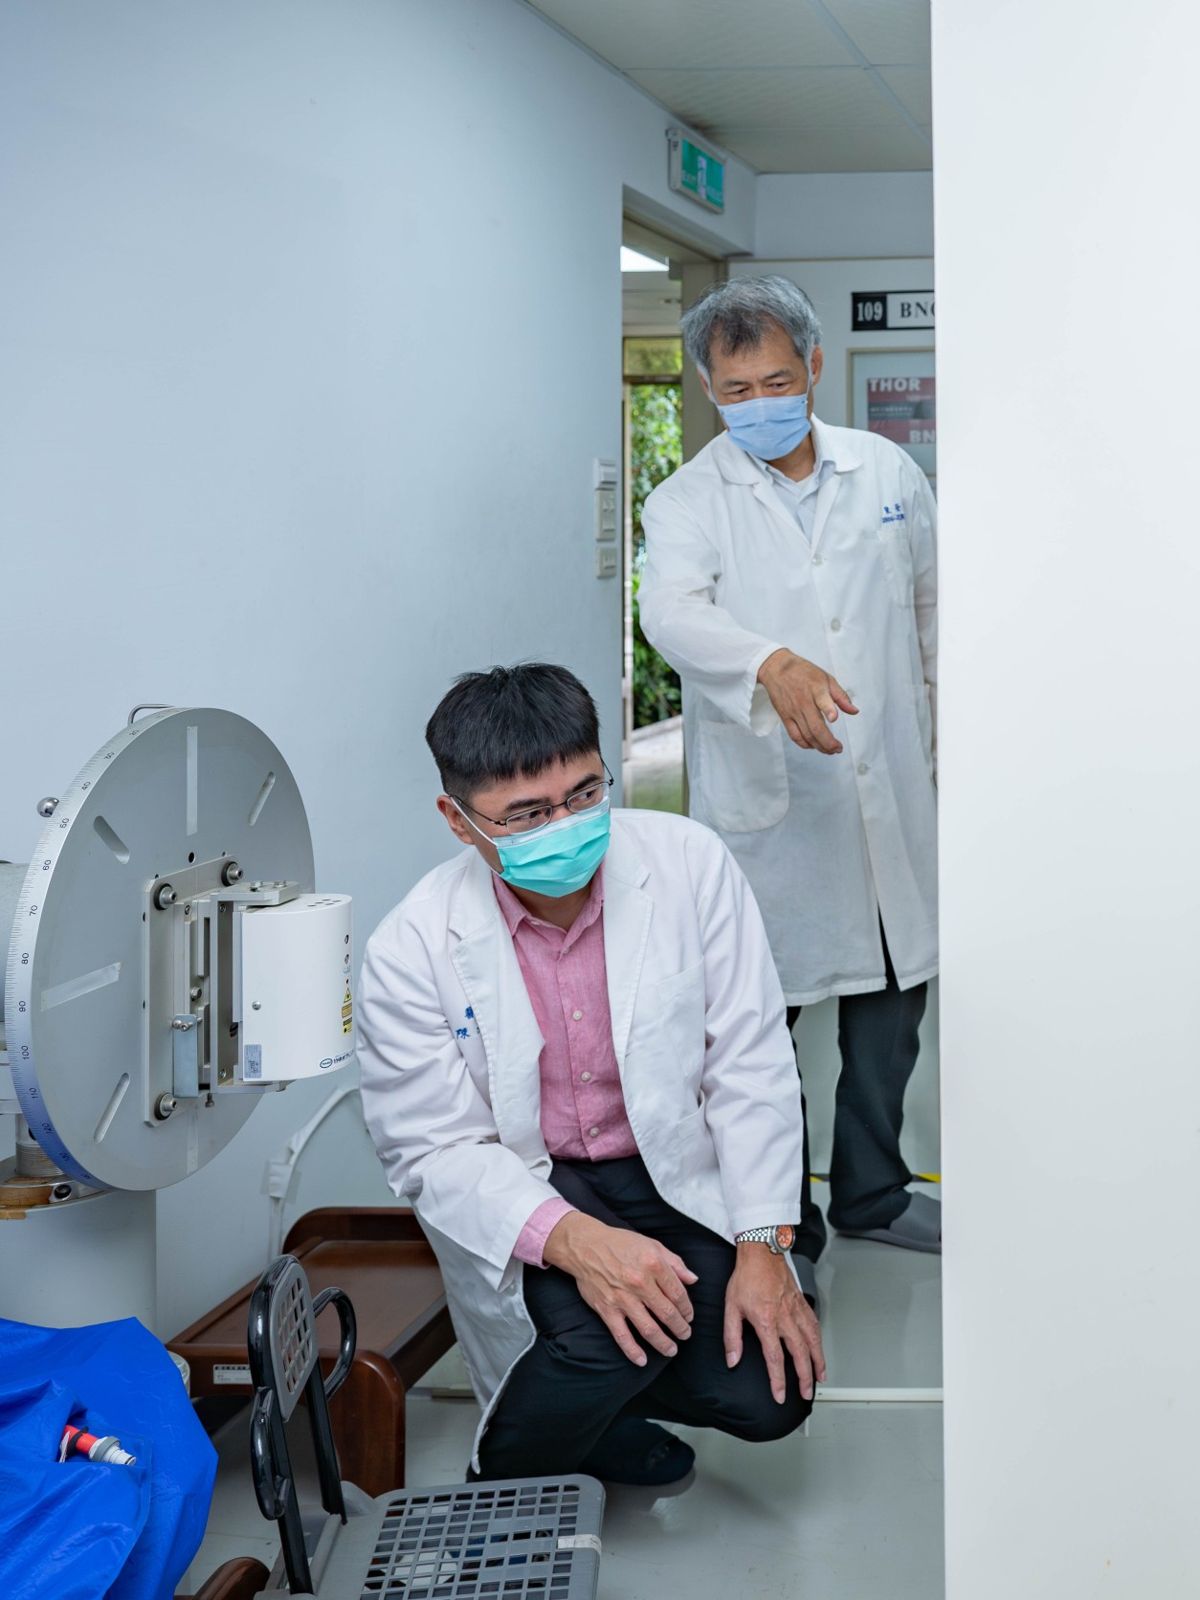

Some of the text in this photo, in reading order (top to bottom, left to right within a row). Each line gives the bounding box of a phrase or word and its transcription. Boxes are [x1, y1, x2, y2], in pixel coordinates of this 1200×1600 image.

[857, 301, 935, 321] 109 BN
[869, 378, 920, 392] THOR
[82, 781, 91, 790] 40
[42, 859, 52, 871] 60
[29, 904, 38, 916] 70
[21, 952, 29, 965] 80
[18, 1000, 26, 1013] 90
[21, 1045, 30, 1060] 100
